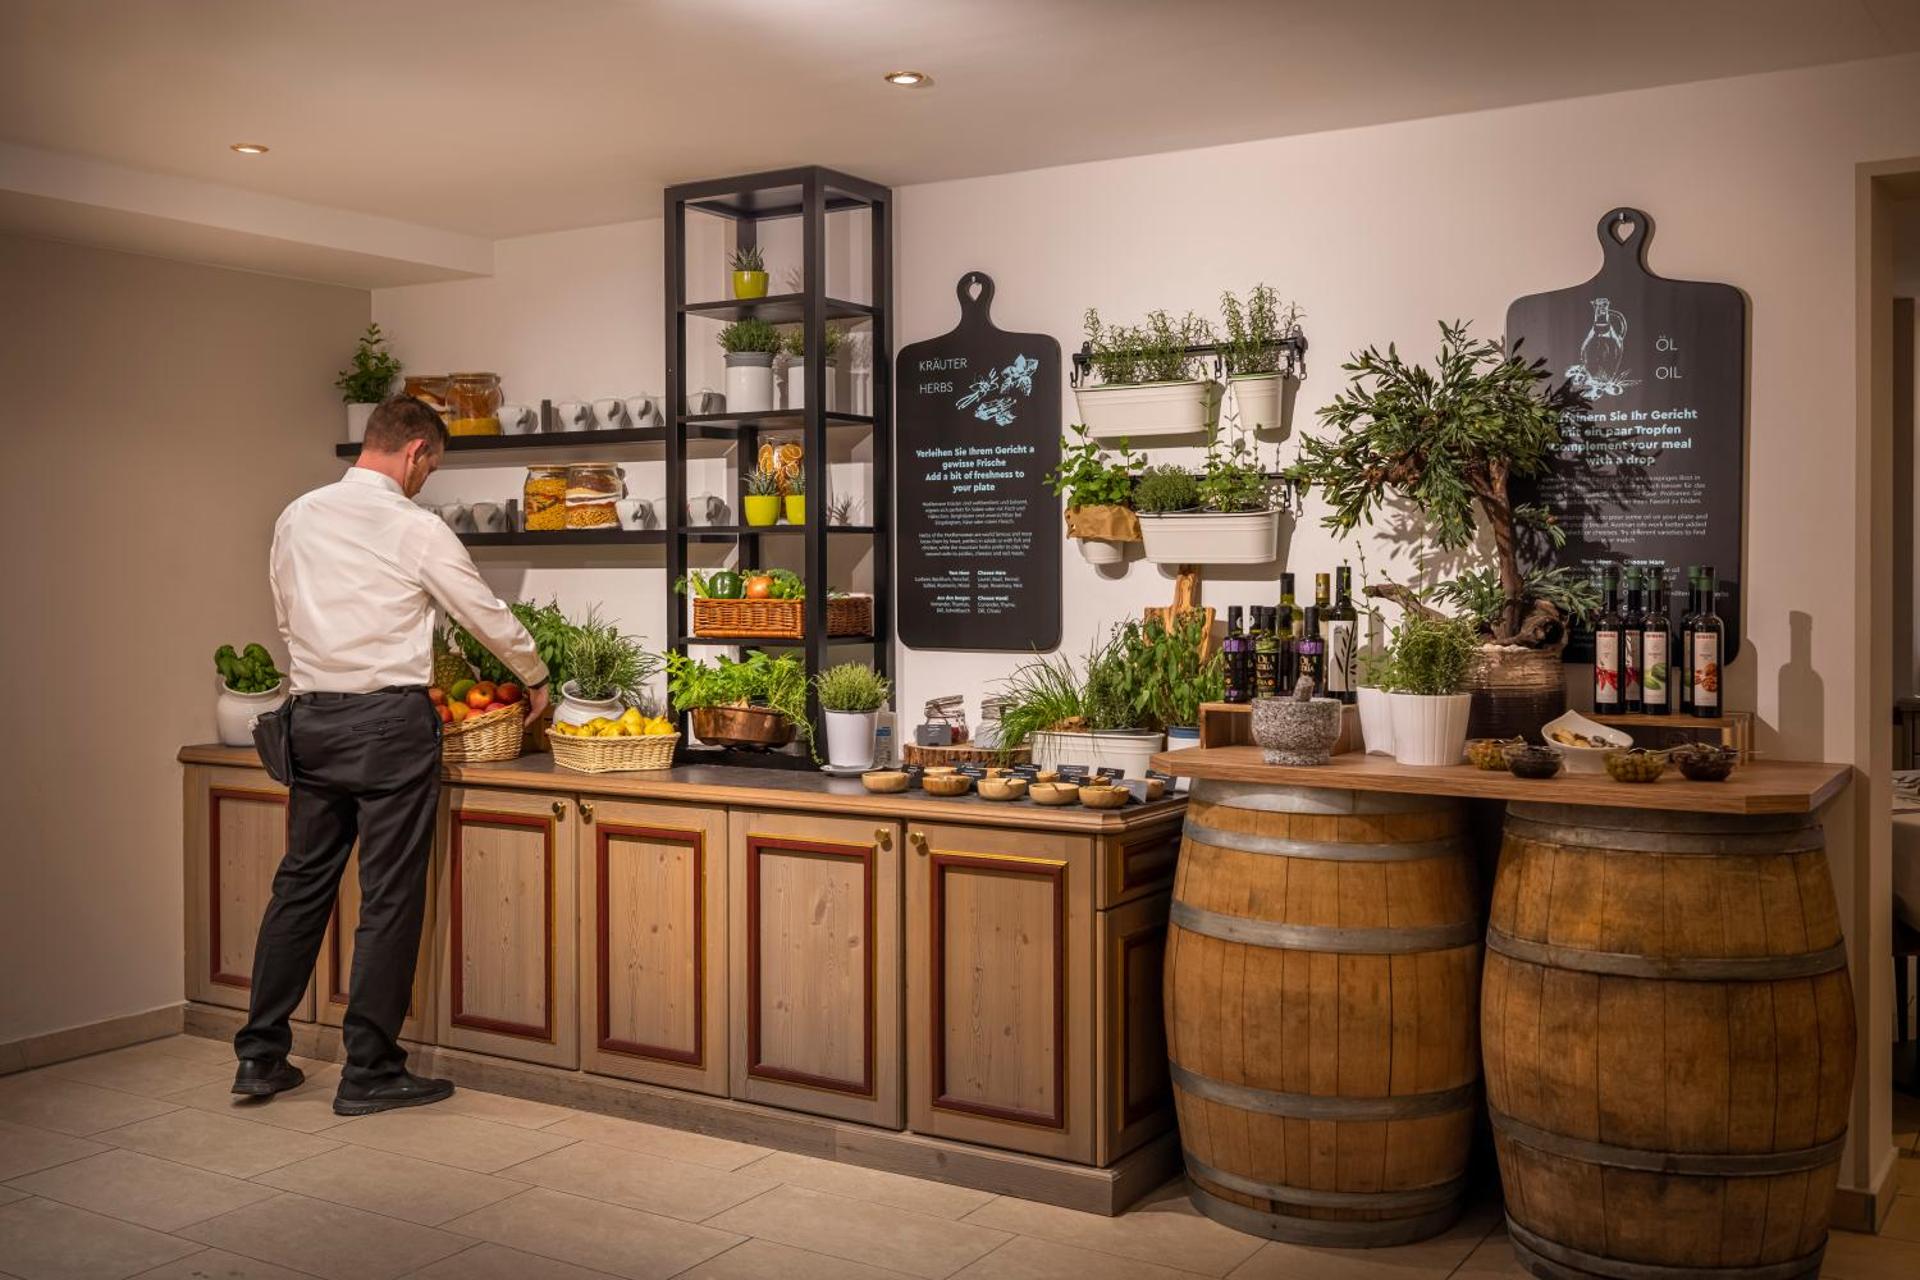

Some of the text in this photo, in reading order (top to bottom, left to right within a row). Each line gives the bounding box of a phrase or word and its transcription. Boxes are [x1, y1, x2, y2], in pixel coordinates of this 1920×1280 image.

[1656, 335, 1678, 352] ÖL
[919, 358, 967, 371] KRÄUTER
[1656, 366, 1682, 380] OIL
[919, 382, 953, 394] HERBS
[1610, 410, 1628, 421] Sie
[1631, 410, 1648, 420] Ihr
[1651, 408, 1698, 420] Gericht
[1634, 424, 1682, 437] Tropfen
[916, 449, 952, 458] Verleihen
[954, 448, 966, 456] Sie
[968, 446, 992, 456] Ihrem
[996, 444, 1026, 454] Gericht
[1630, 440, 1658, 451] your
[1662, 438, 1692, 449] meal
[942, 458, 1006, 470] gewisse Frische
[1586, 455, 1612, 466] with
[1626, 455, 1656, 466] drop
[926, 472, 941, 481] Add
[950, 472, 962, 480] bit
[964, 471, 972, 480] of
[974, 470, 1013, 480] freshness
[1015, 470, 1024, 478] to
[952, 482, 996, 494] your plate
